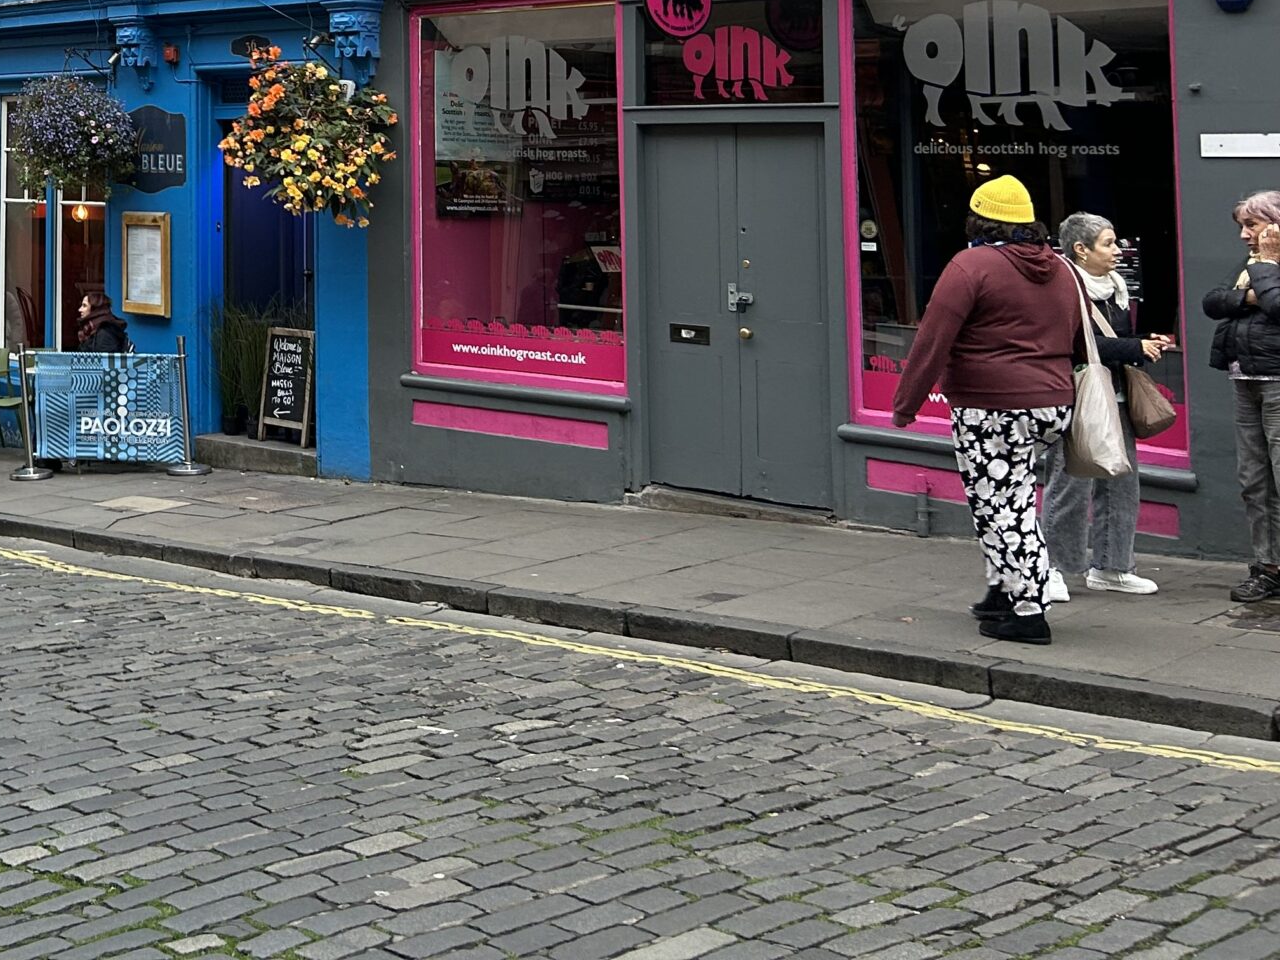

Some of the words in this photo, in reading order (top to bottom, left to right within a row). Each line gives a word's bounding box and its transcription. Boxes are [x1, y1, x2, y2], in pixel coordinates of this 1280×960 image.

[556, 149, 587, 158] roasts
[913, 142, 974, 155] delicious
[976, 142, 1035, 155] scottish
[1038, 142, 1068, 158] hog
[1071, 142, 1121, 155] roasts
[141, 153, 184, 172] BLEUE
[545, 171, 563, 180] HOG
[272, 351, 302, 364] MAISON
[451, 343, 587, 365] www.oinkhogroast.co.uk
[272, 361, 294, 374] Bleue
[271, 379, 293, 389] HAGGIS
[80, 414, 172, 438] PAOLOZZI
[120, 436, 133, 444] THE
[134, 437, 170, 445] EVERYDAY
